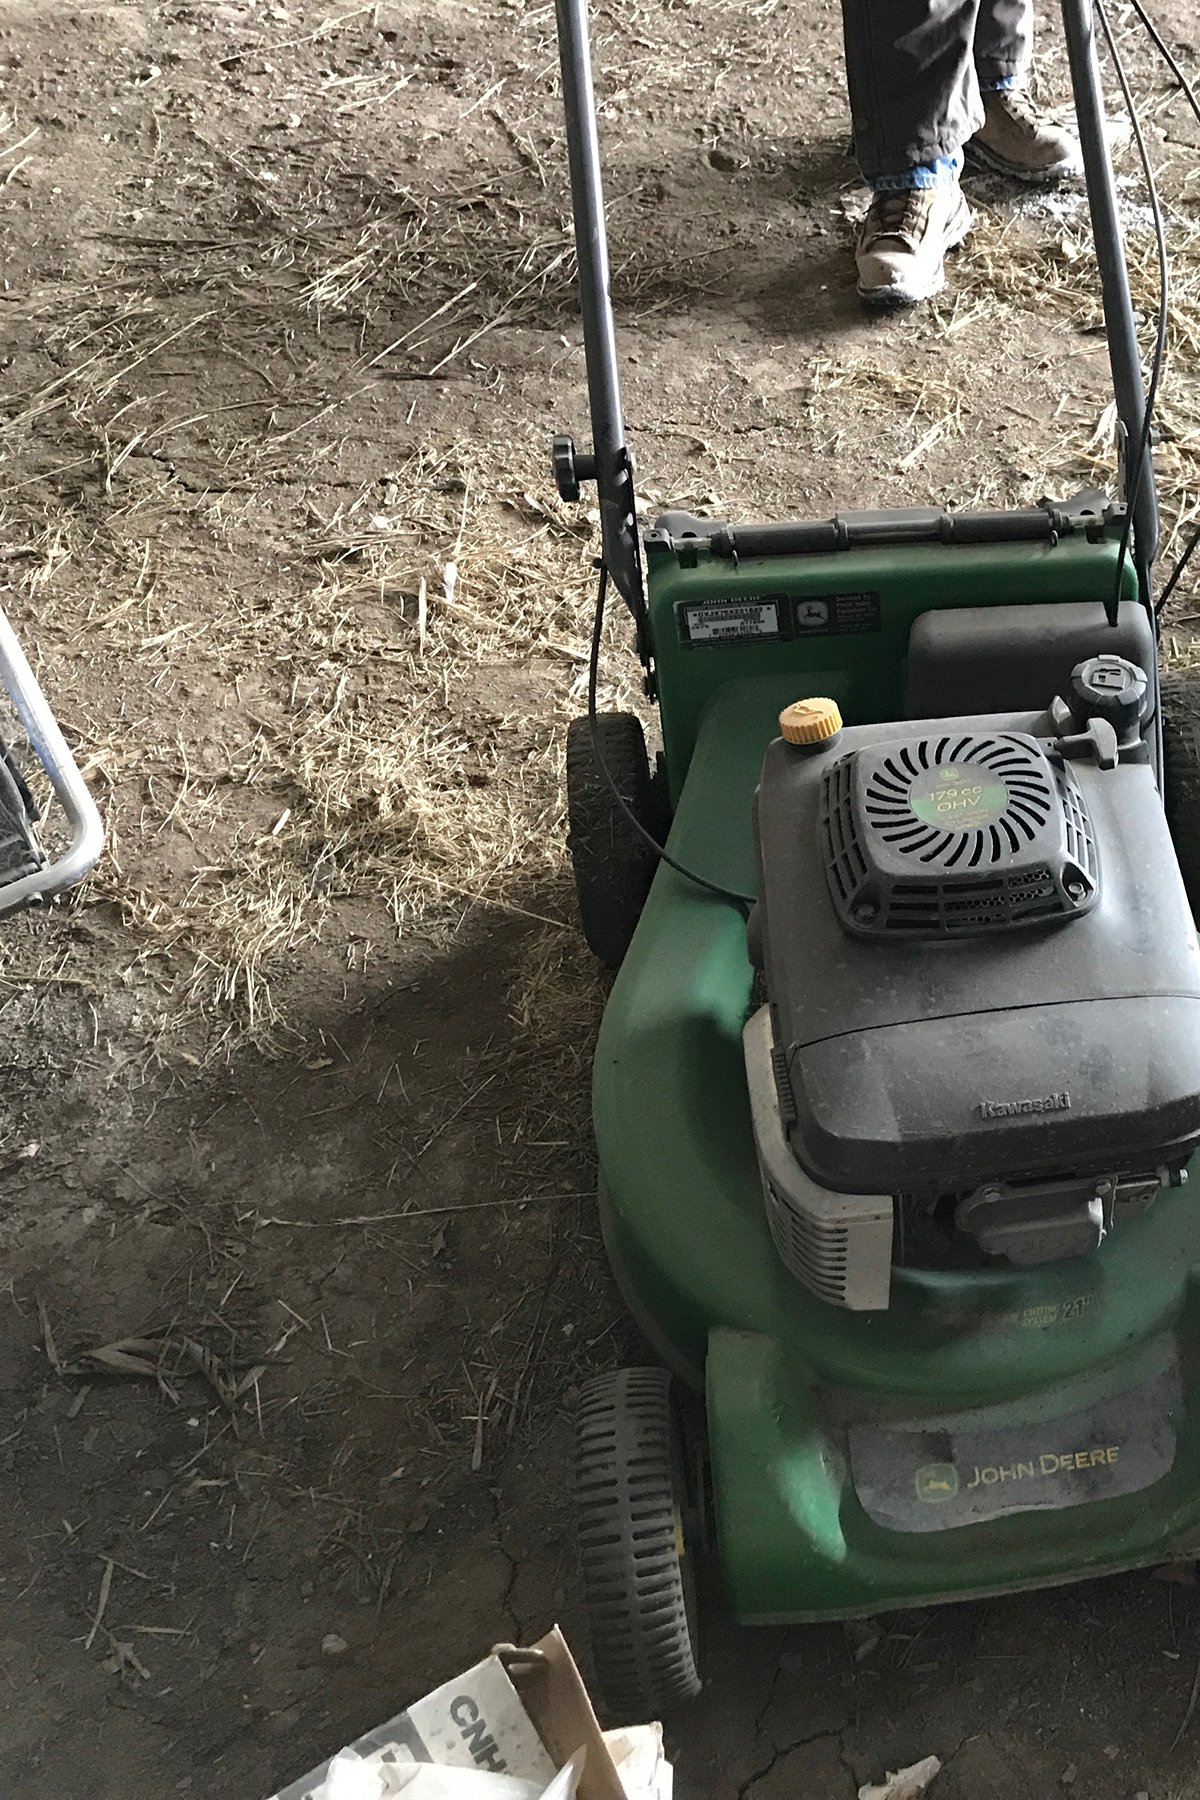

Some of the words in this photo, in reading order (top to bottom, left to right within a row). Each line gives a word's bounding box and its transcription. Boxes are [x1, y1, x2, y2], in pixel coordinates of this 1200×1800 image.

[928, 788, 958, 802] 179
[961, 785, 982, 796] cc
[937, 796, 981, 813] OHV
[980, 1091, 1071, 1119] Kawasaki
[967, 1460, 1035, 1488] JOHN
[1039, 1446, 1121, 1475] DEERE
[450, 1695, 509, 1773] CNH
